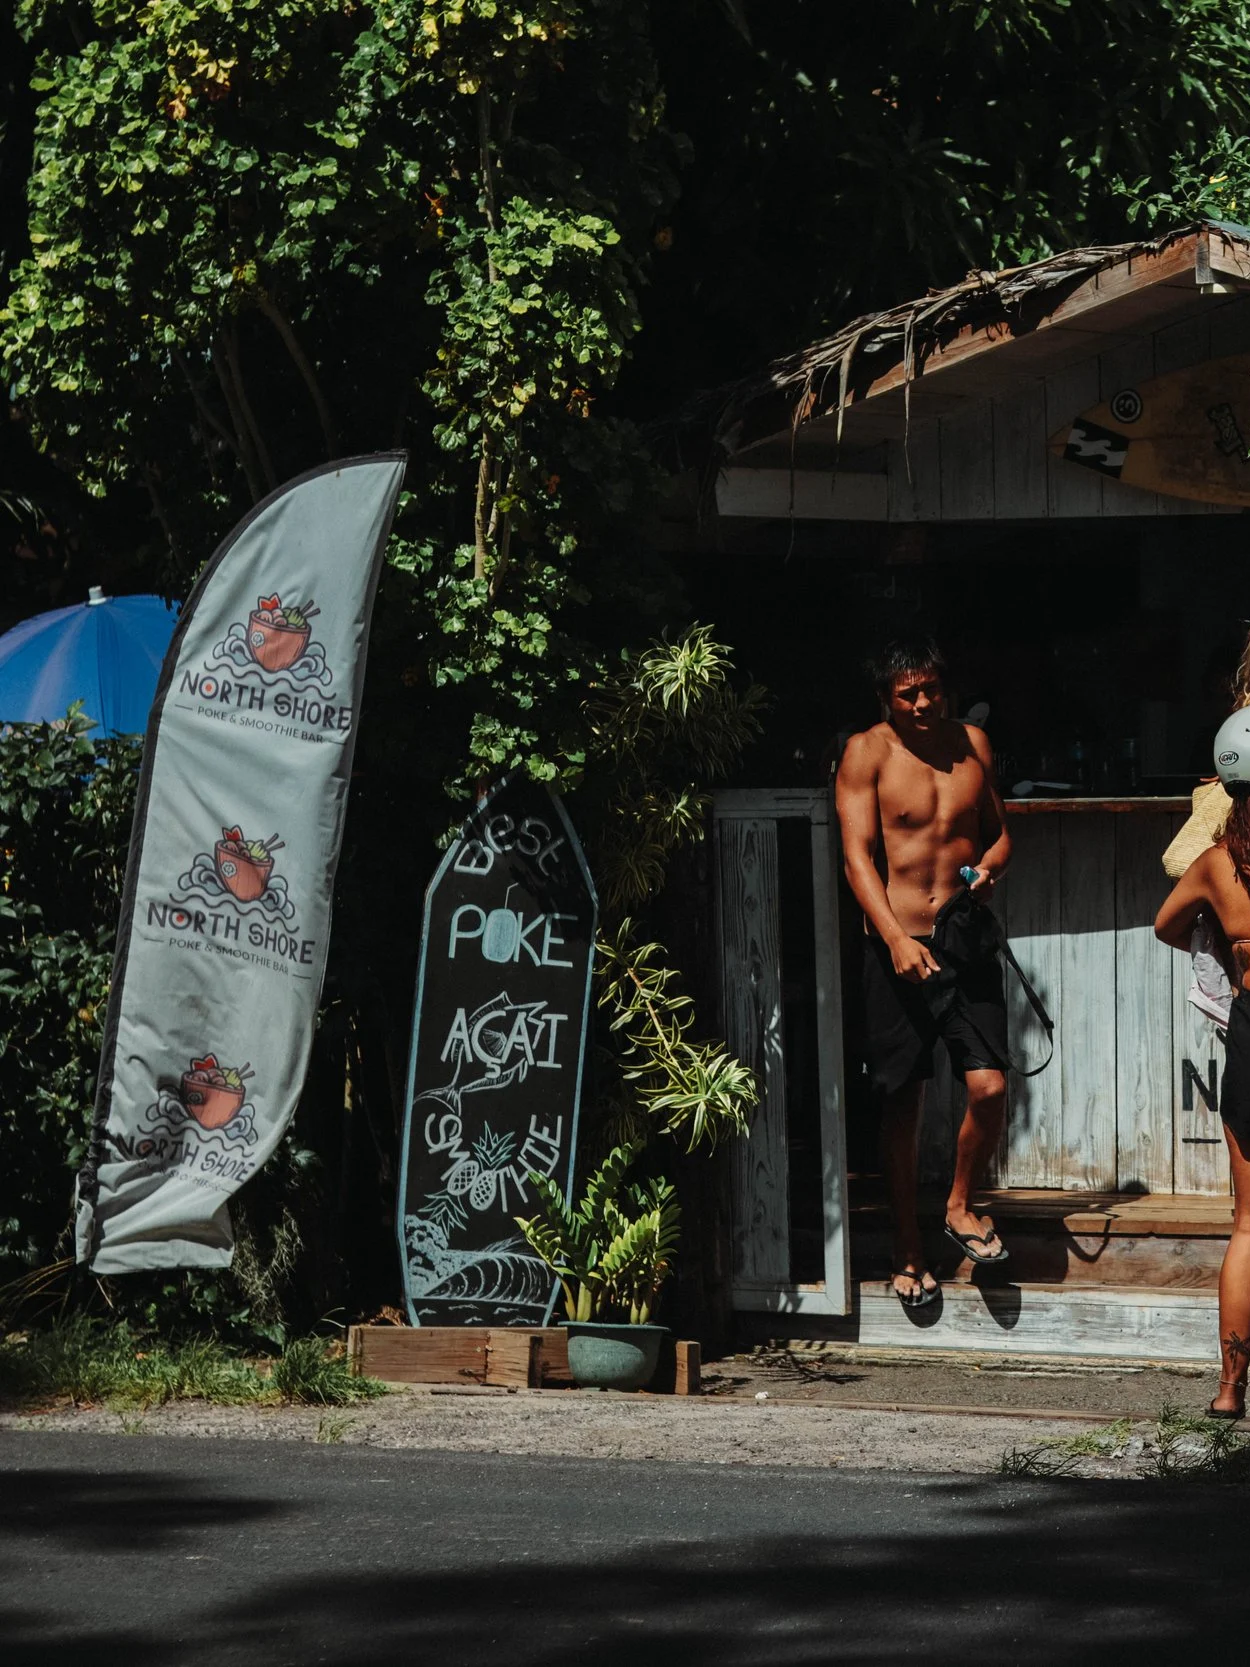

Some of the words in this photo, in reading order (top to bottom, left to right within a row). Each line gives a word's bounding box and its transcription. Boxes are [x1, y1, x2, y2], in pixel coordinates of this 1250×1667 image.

[179, 669, 265, 711] NORTH
[273, 692, 353, 730] SHORE
[197, 706, 227, 721] POKE
[229, 715, 237, 724] &
[239, 716, 298, 738] SMOOTHIE
[301, 729, 324, 743] BAR
[147, 902, 240, 940] NORTH
[248, 923, 316, 964] SHORE
[168, 938, 201, 951] POKE
[204, 943, 212, 952] &
[215, 945, 271, 969] SMOOTHIE
[273, 960, 289, 975] BAR
[448, 904, 579, 968] POKE
[440, 1007, 568, 1079] AÇAI
[116, 1132, 199, 1167] NORTH
[424, 1113, 562, 1213] SMOOTHIE
